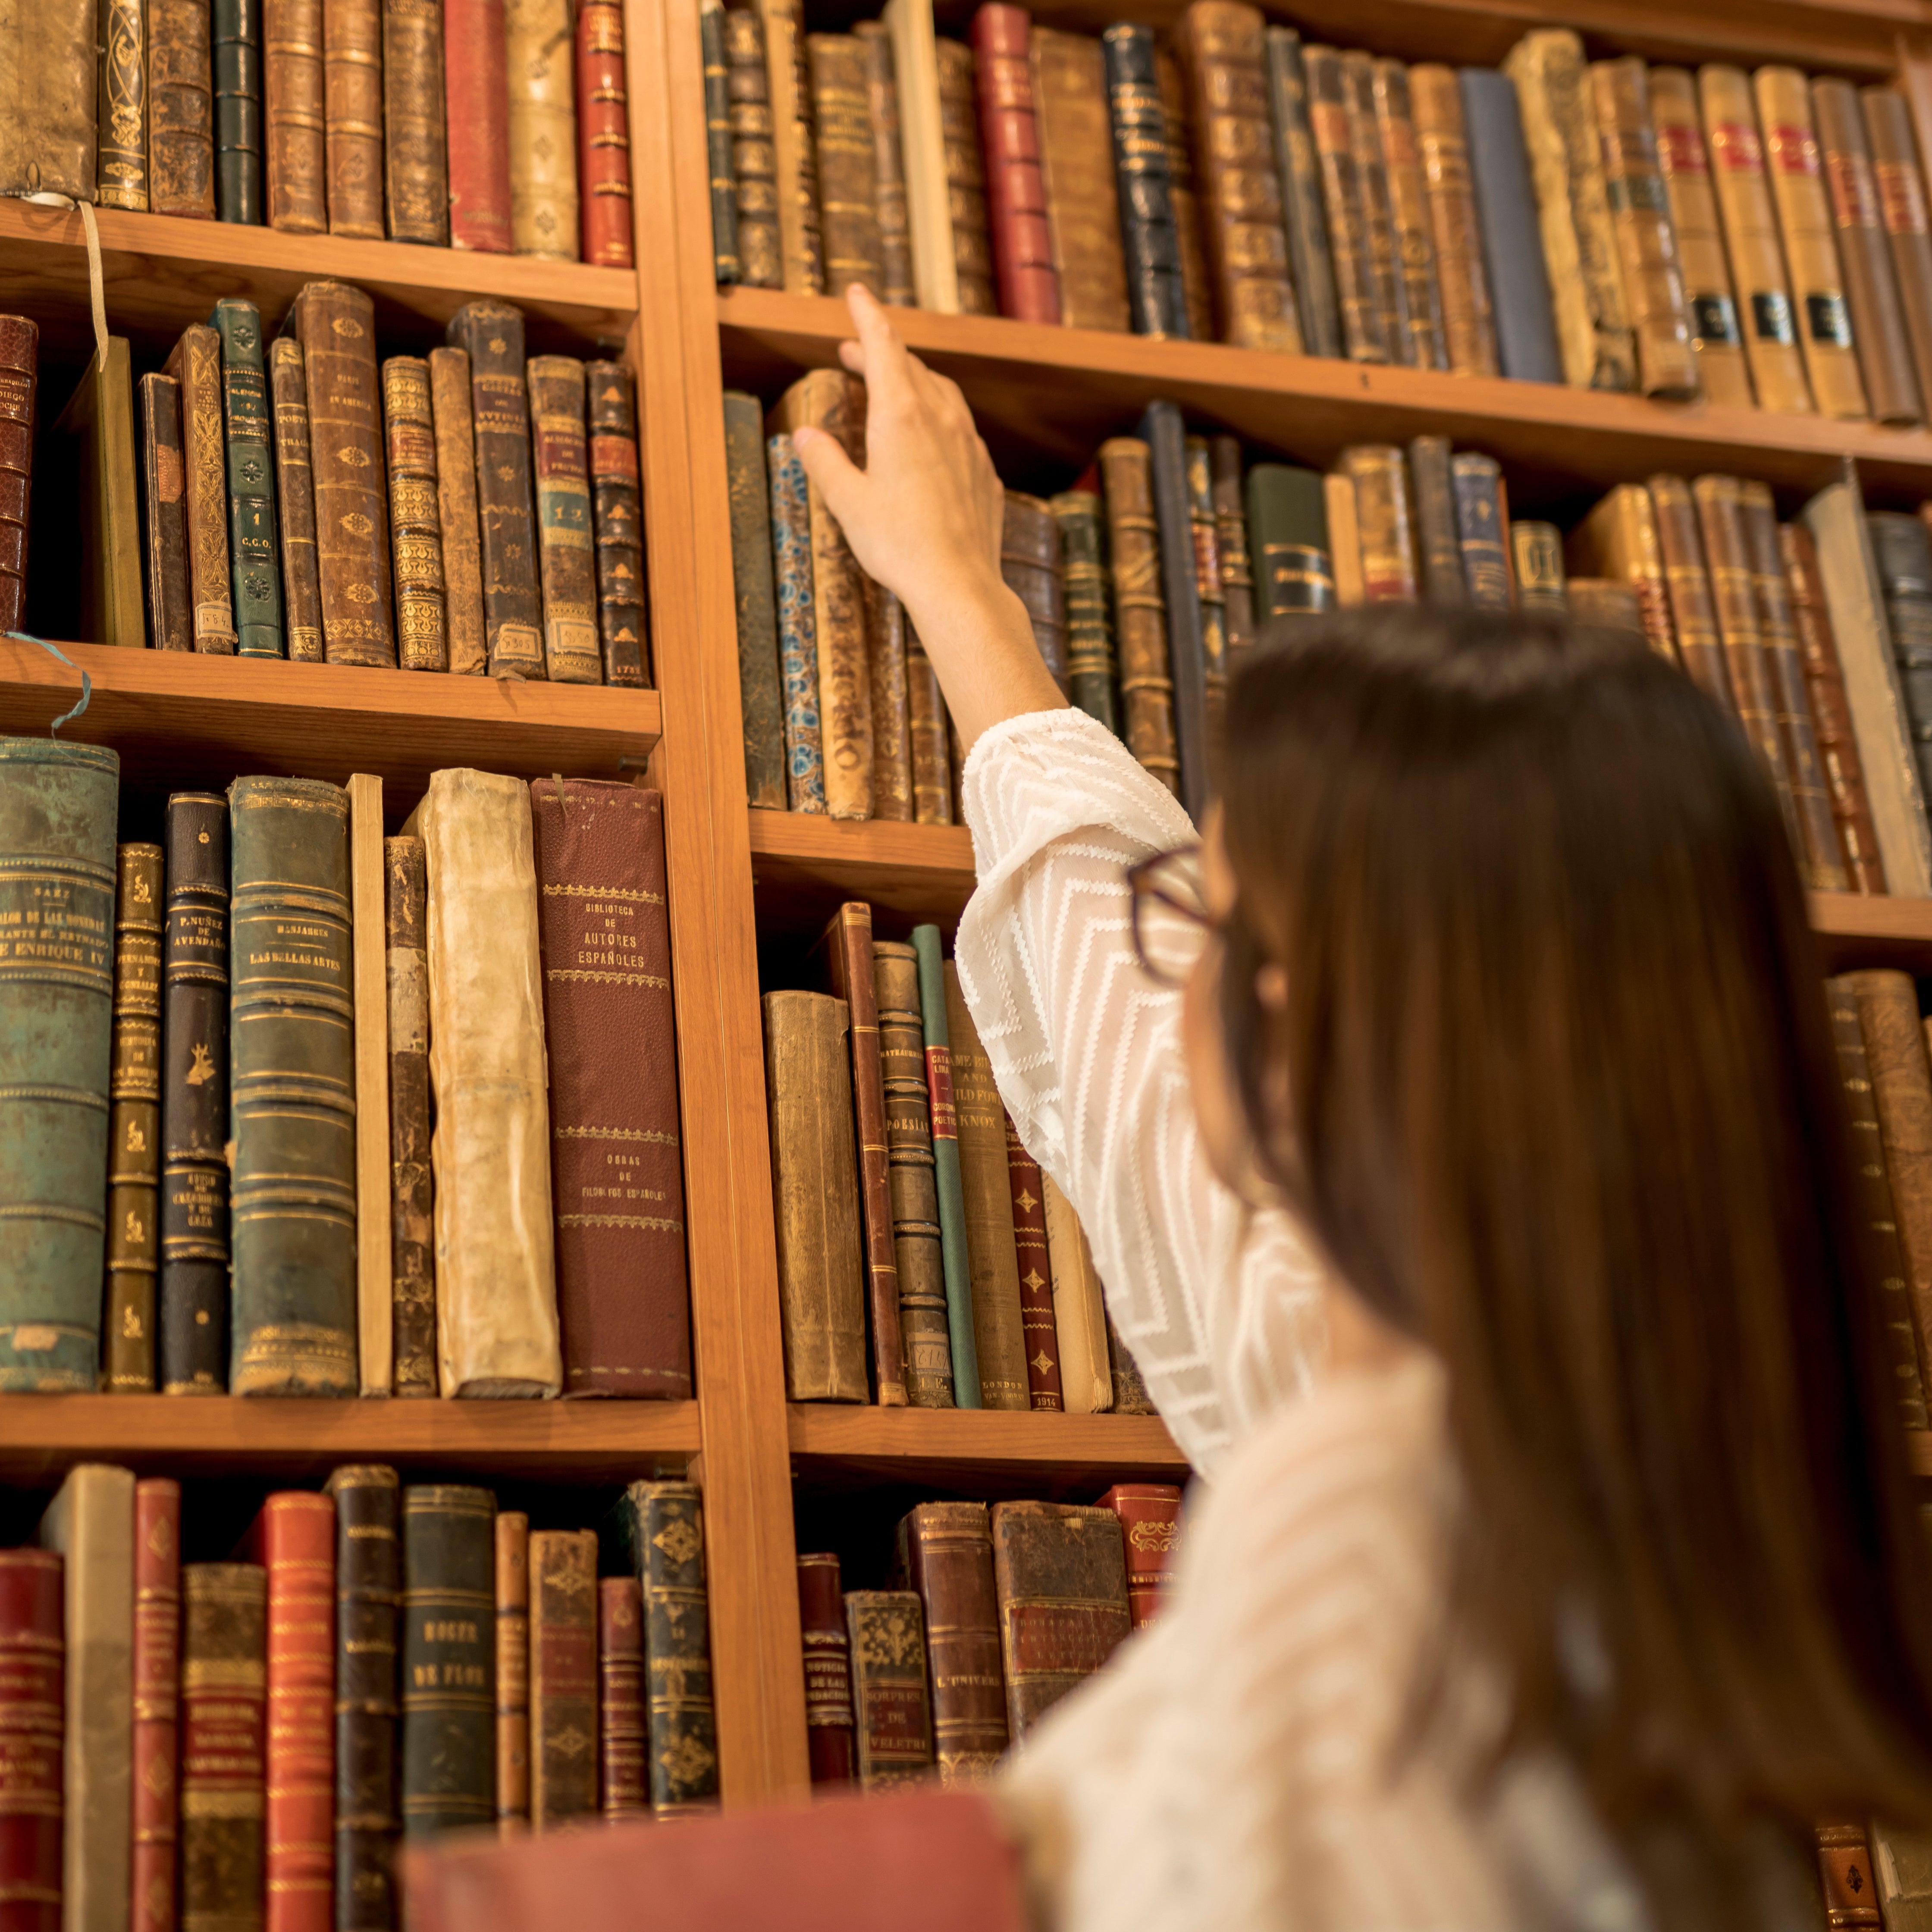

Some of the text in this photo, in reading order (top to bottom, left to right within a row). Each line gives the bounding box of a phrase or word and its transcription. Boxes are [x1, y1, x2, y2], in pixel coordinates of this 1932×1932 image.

[253, 513, 260, 526] 1
[34, 887, 70, 898] SAEZ
[585, 903, 634, 916] BIBLIOTECA
[605, 918, 616, 928] DE
[198, 927, 210, 936] DE
[584, 932, 637, 948] AUTORES
[15, 943, 83, 961] ENRIQUE
[91, 951, 104, 965] IV
[578, 950, 645, 968] ESPAÑOLES
[249, 951, 341, 971] LAS BELLAS ARTES
[934, 1064, 950, 1073] LINA
[963, 1073, 988, 1083] AND
[959, 1115, 996, 1129] KNOX
[607, 1154, 640, 1166] OBRAS
[619, 1171, 631, 1182] DE
[982, 1380, 1022, 1389] LONDON
[1037, 1397, 1056, 1408] 1914
